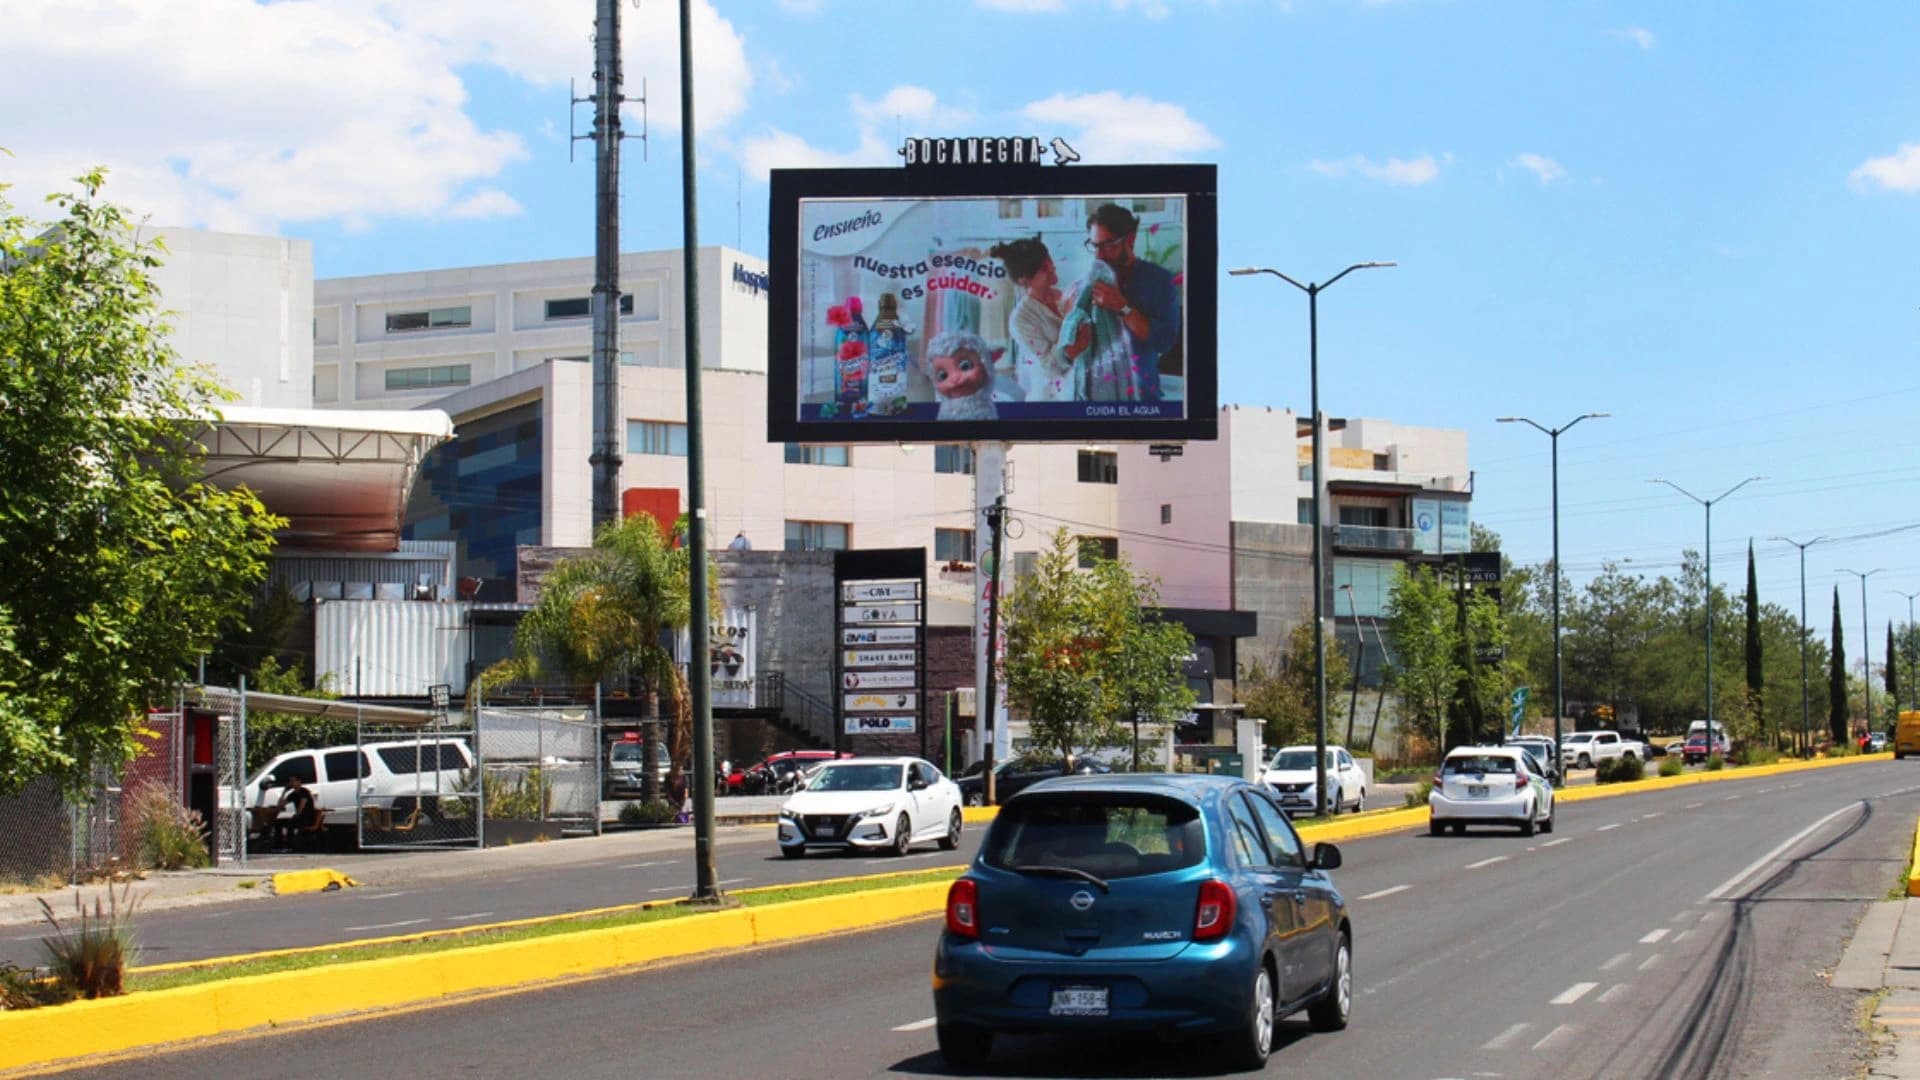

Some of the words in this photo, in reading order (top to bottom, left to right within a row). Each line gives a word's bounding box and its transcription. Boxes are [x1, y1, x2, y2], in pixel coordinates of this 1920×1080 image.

[905, 137, 1039, 164] BOCANEGRA
[813, 209, 883, 242] ensueño
[733, 261, 768, 295] Hospi
[854, 255, 929, 279] nuestra
[901, 285, 924, 300] es
[1086, 406, 1116, 416] CUIDA
[1119, 406, 1130, 416] EL
[708, 625, 749, 639] ACOS
